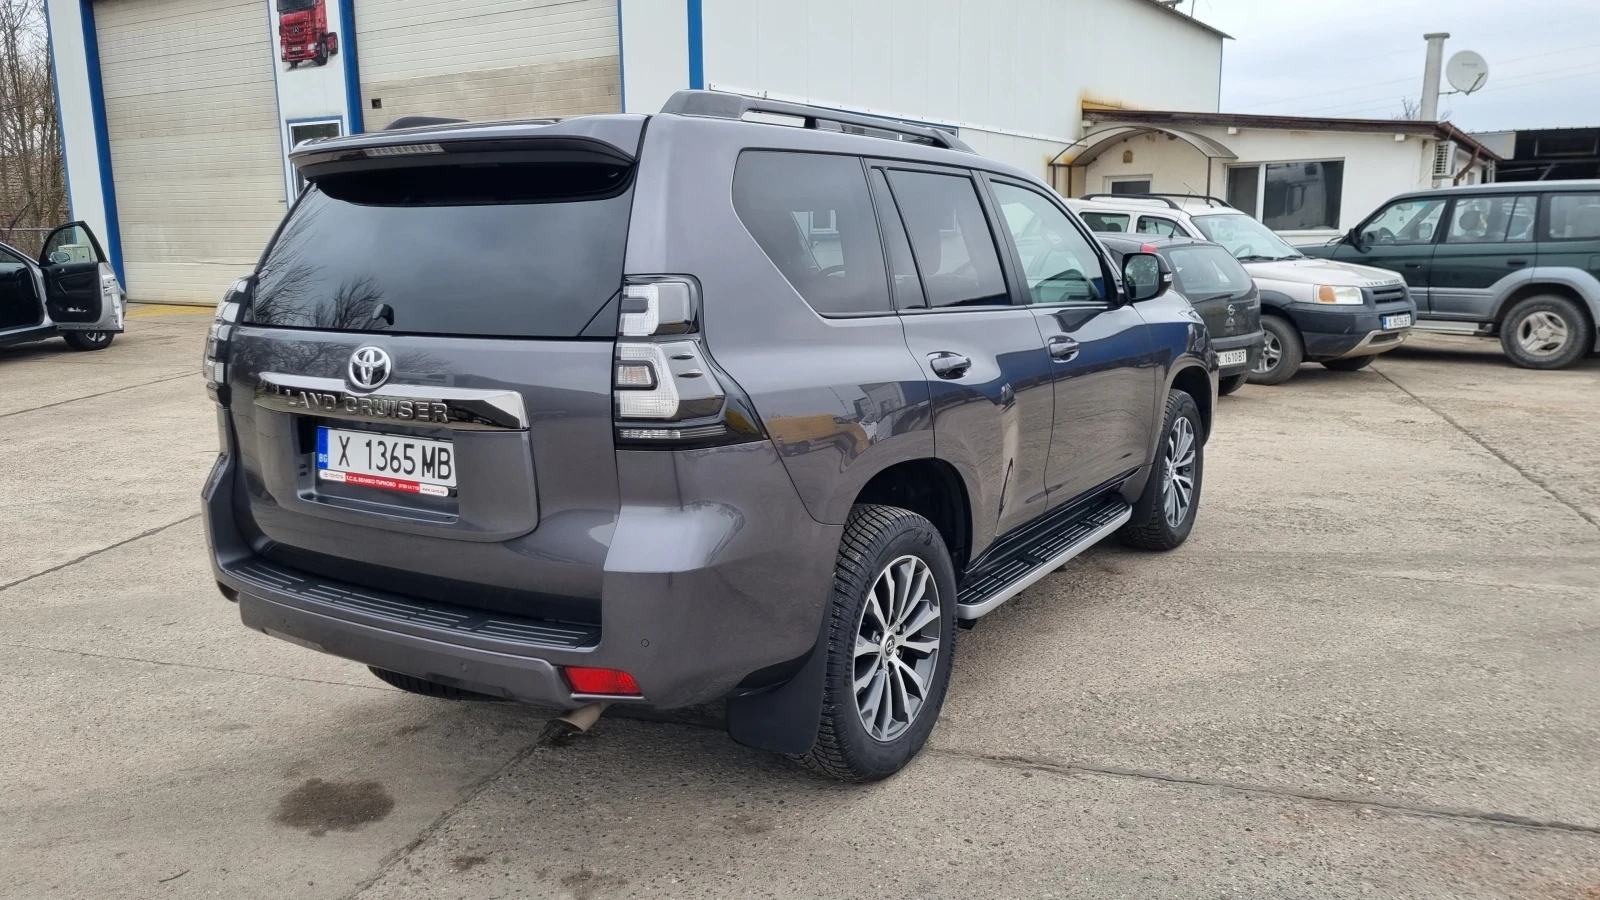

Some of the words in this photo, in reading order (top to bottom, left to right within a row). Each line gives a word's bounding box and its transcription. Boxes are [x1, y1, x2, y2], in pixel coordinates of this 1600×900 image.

[285, 389, 337, 413] LAND
[344, 395, 449, 424] CRUISER
[318, 453, 328, 463] BG
[338, 435, 351, 468] X
